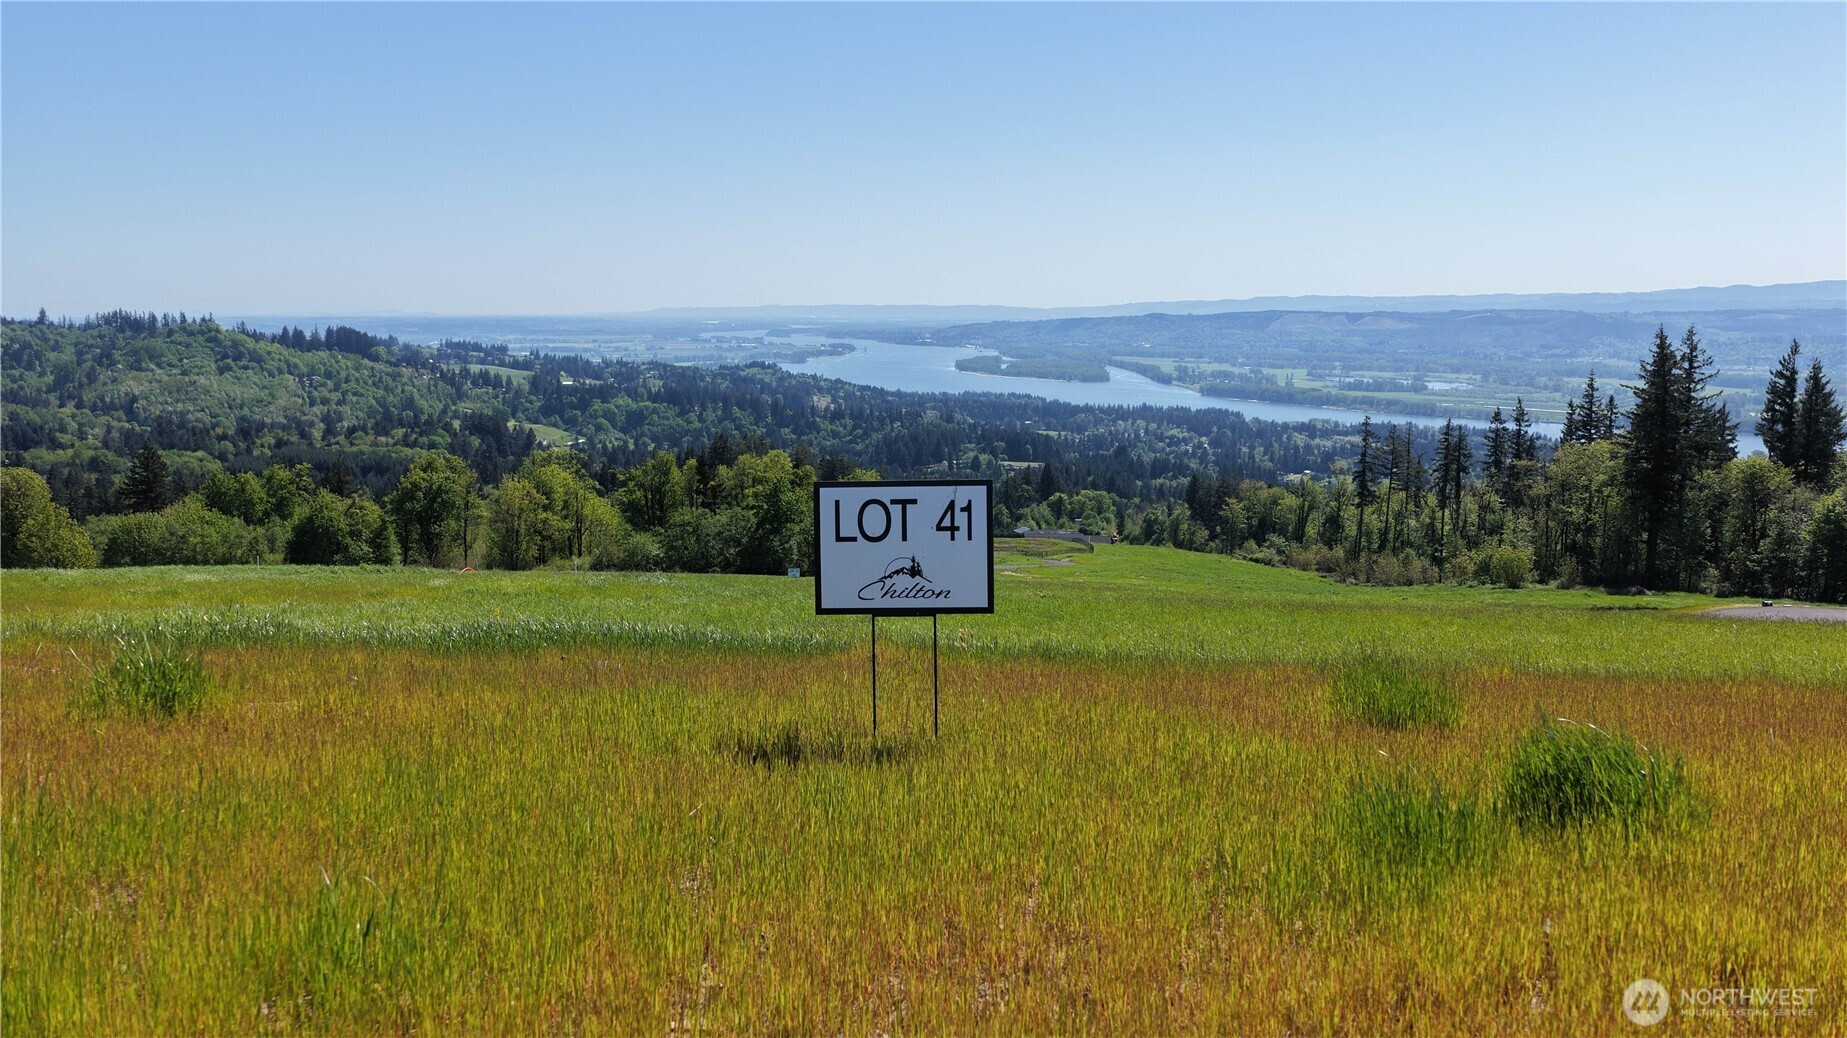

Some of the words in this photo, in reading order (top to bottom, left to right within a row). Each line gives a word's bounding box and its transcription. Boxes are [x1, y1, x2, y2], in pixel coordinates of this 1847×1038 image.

[835, 499, 918, 542] LOT
[935, 499, 973, 541] 41
[857, 580, 951, 600] Chilton
